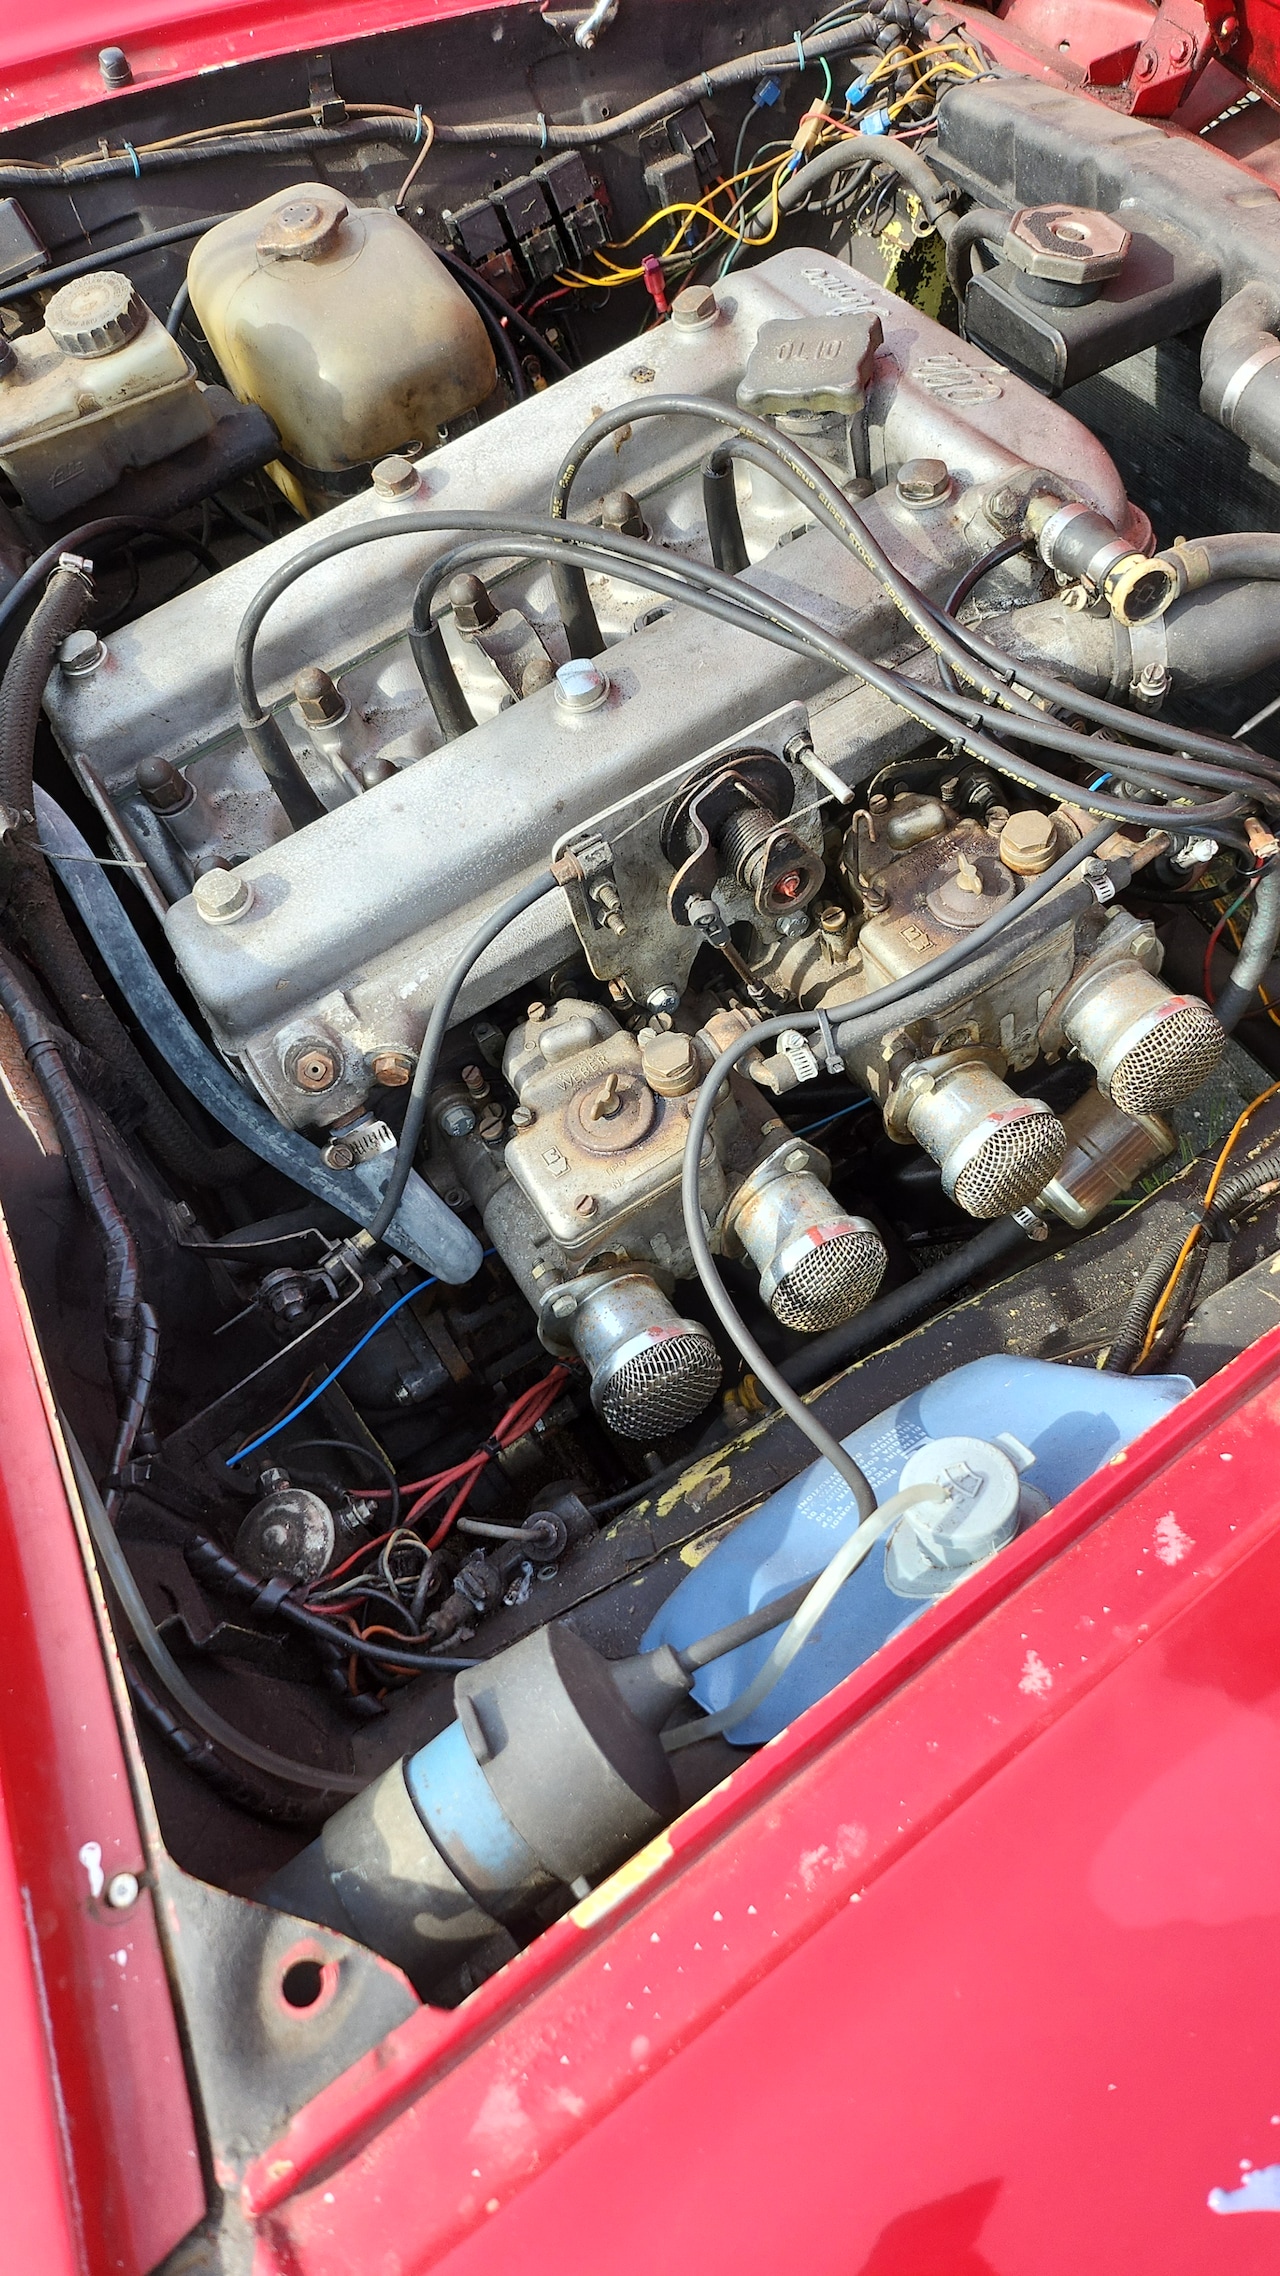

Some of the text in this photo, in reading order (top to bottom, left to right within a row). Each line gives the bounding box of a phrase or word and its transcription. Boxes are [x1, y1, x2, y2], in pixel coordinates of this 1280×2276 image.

[816, 491, 848, 530] SUPER
[846, 530, 878, 572] STOCK
[880, 580, 913, 621] SPIRAL
[912, 622, 944, 655] CORE
[979, 683, 1013, 712] WRE
[557, 1055, 609, 1091] WEBER
[881, 1433, 910, 1455] ACQUA
[806, 1510, 817, 1520] DI
